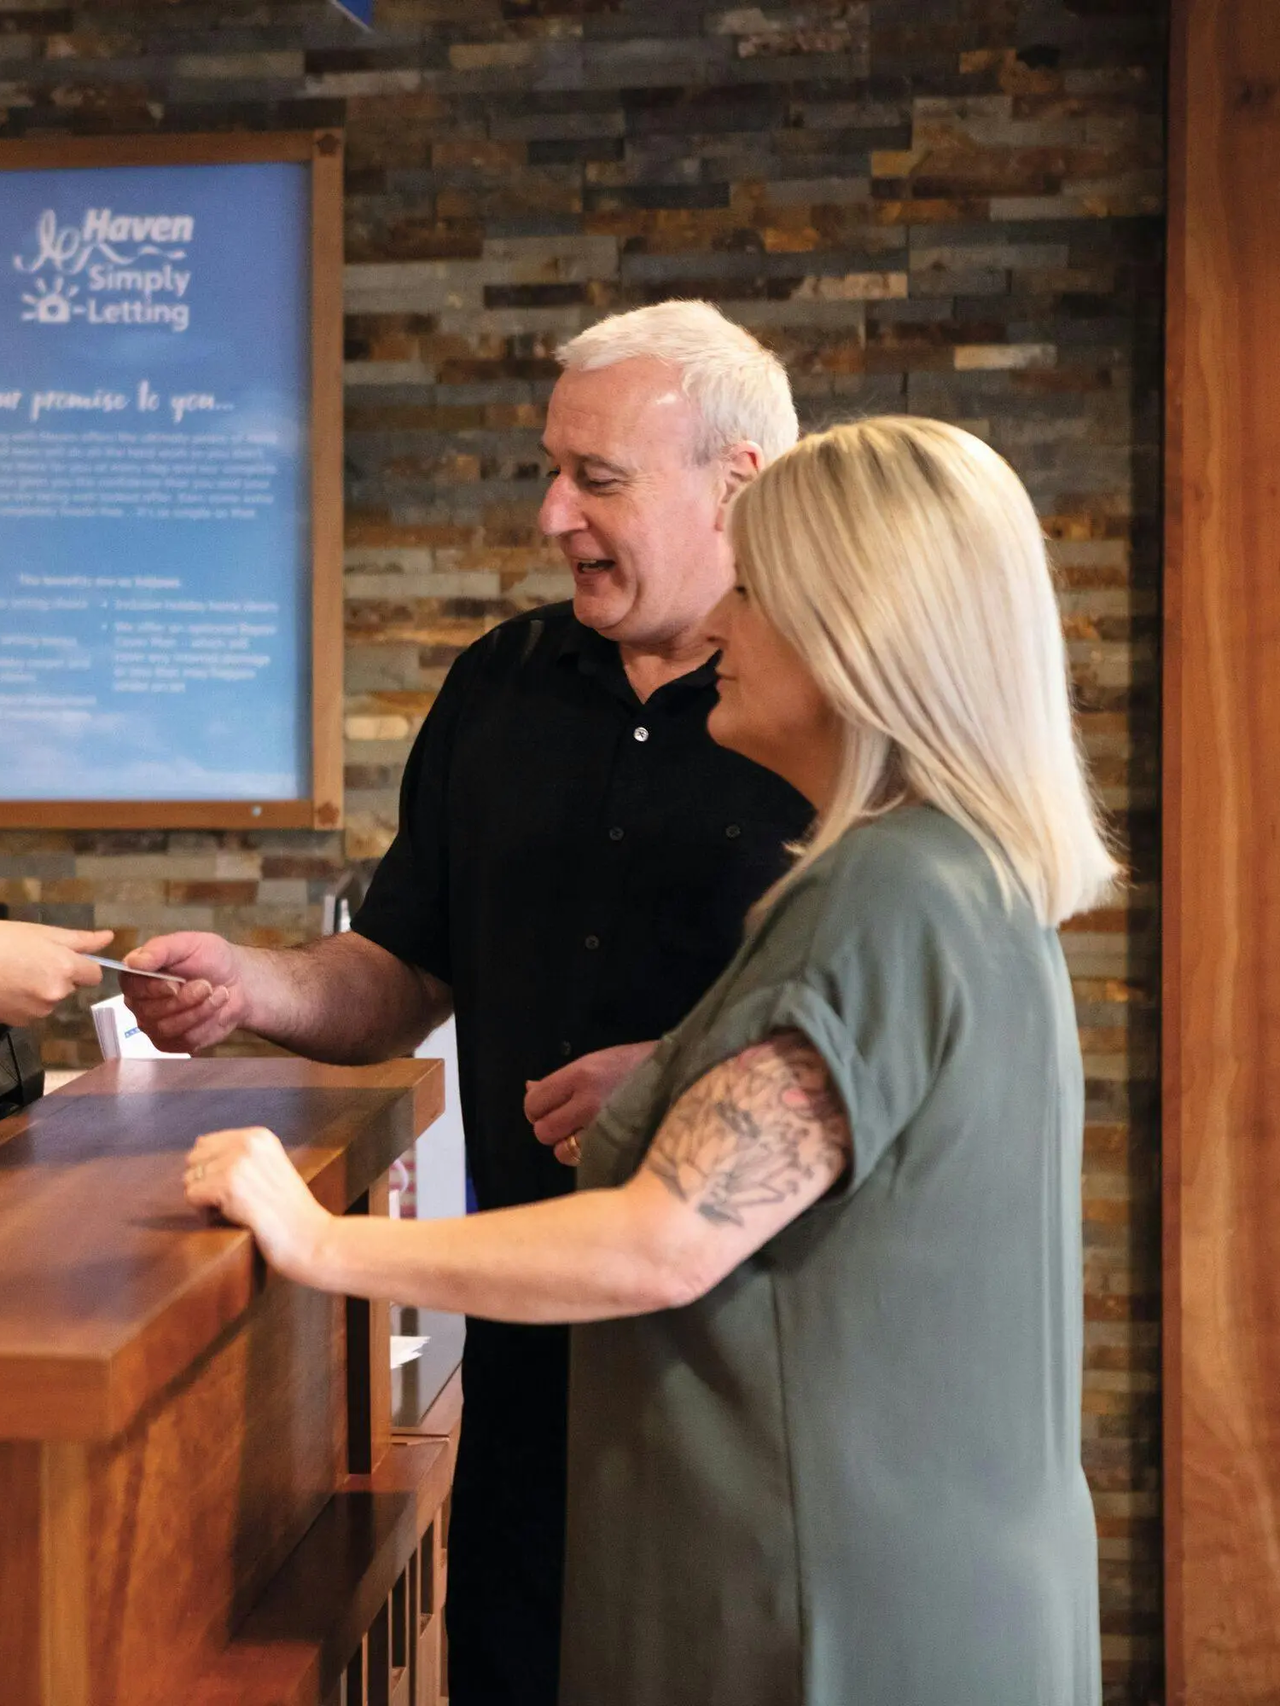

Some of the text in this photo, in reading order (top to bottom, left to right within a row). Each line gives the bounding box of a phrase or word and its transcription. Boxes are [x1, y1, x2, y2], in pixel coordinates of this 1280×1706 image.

[83, 208, 194, 242] Haven
[89, 264, 191, 299] Simply
[30, 389, 127, 423] promise
[137, 379, 160, 412] to
